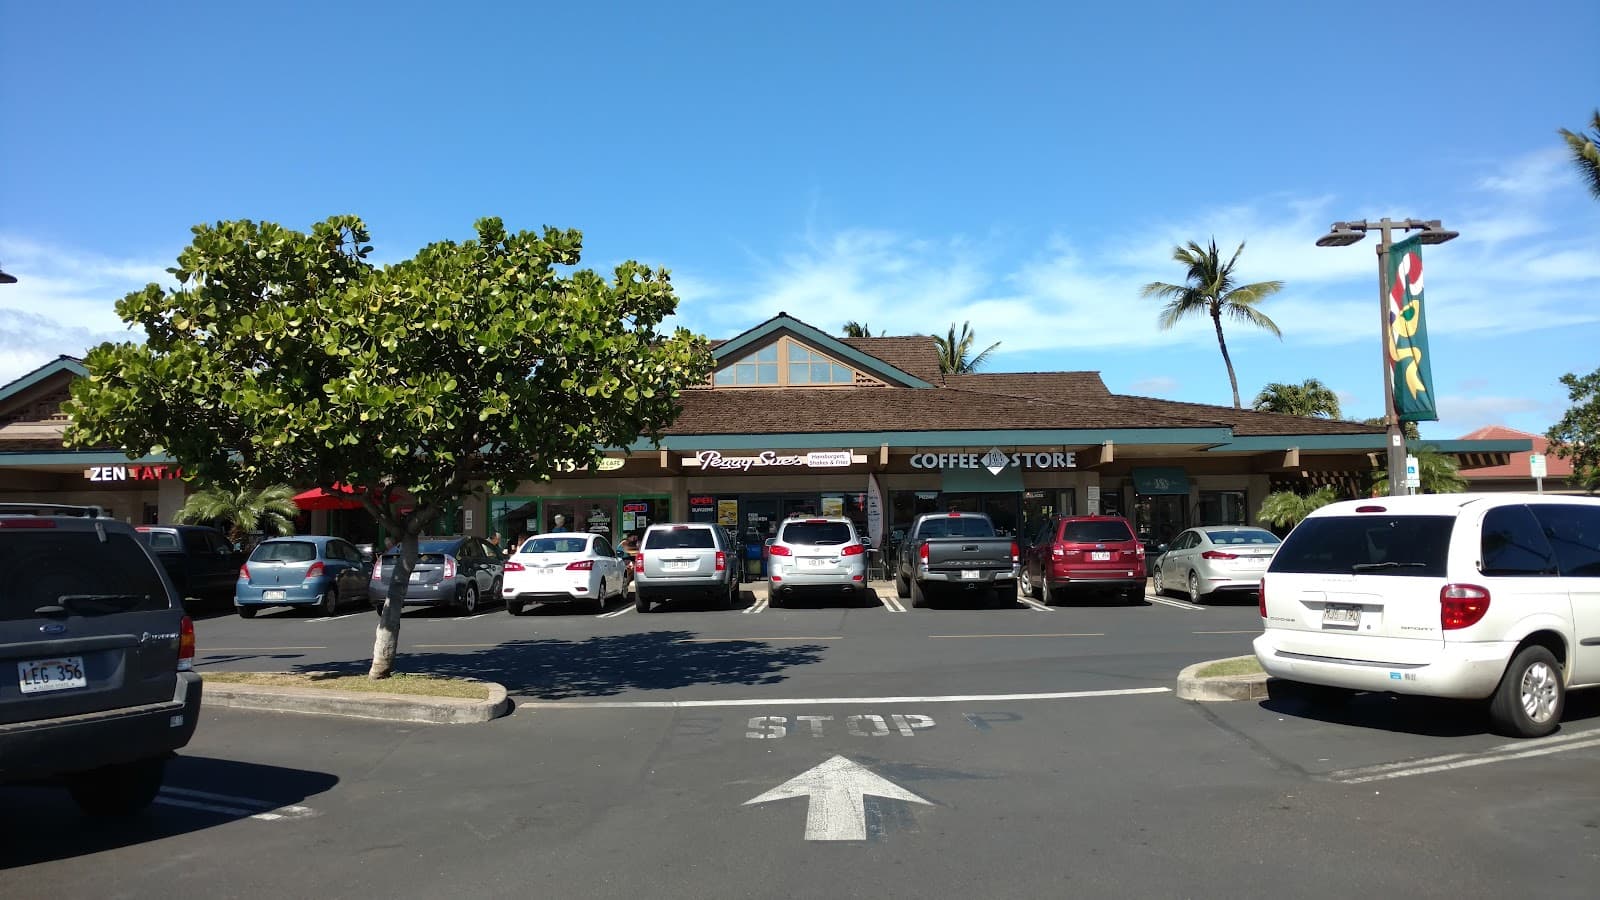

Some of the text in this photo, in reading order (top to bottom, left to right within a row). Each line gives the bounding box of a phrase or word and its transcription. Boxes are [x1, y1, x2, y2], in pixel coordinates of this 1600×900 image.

[700, 450, 803, 471] Peggy Sue's
[909, 452, 979, 469] COFFEE
[1010, 452, 1077, 468] STORE
[90, 466, 183, 481] ZEN TAT
[690, 497, 713, 505] OPEN
[22, 664, 82, 686] LEG 356
[745, 713, 937, 740] STOP
